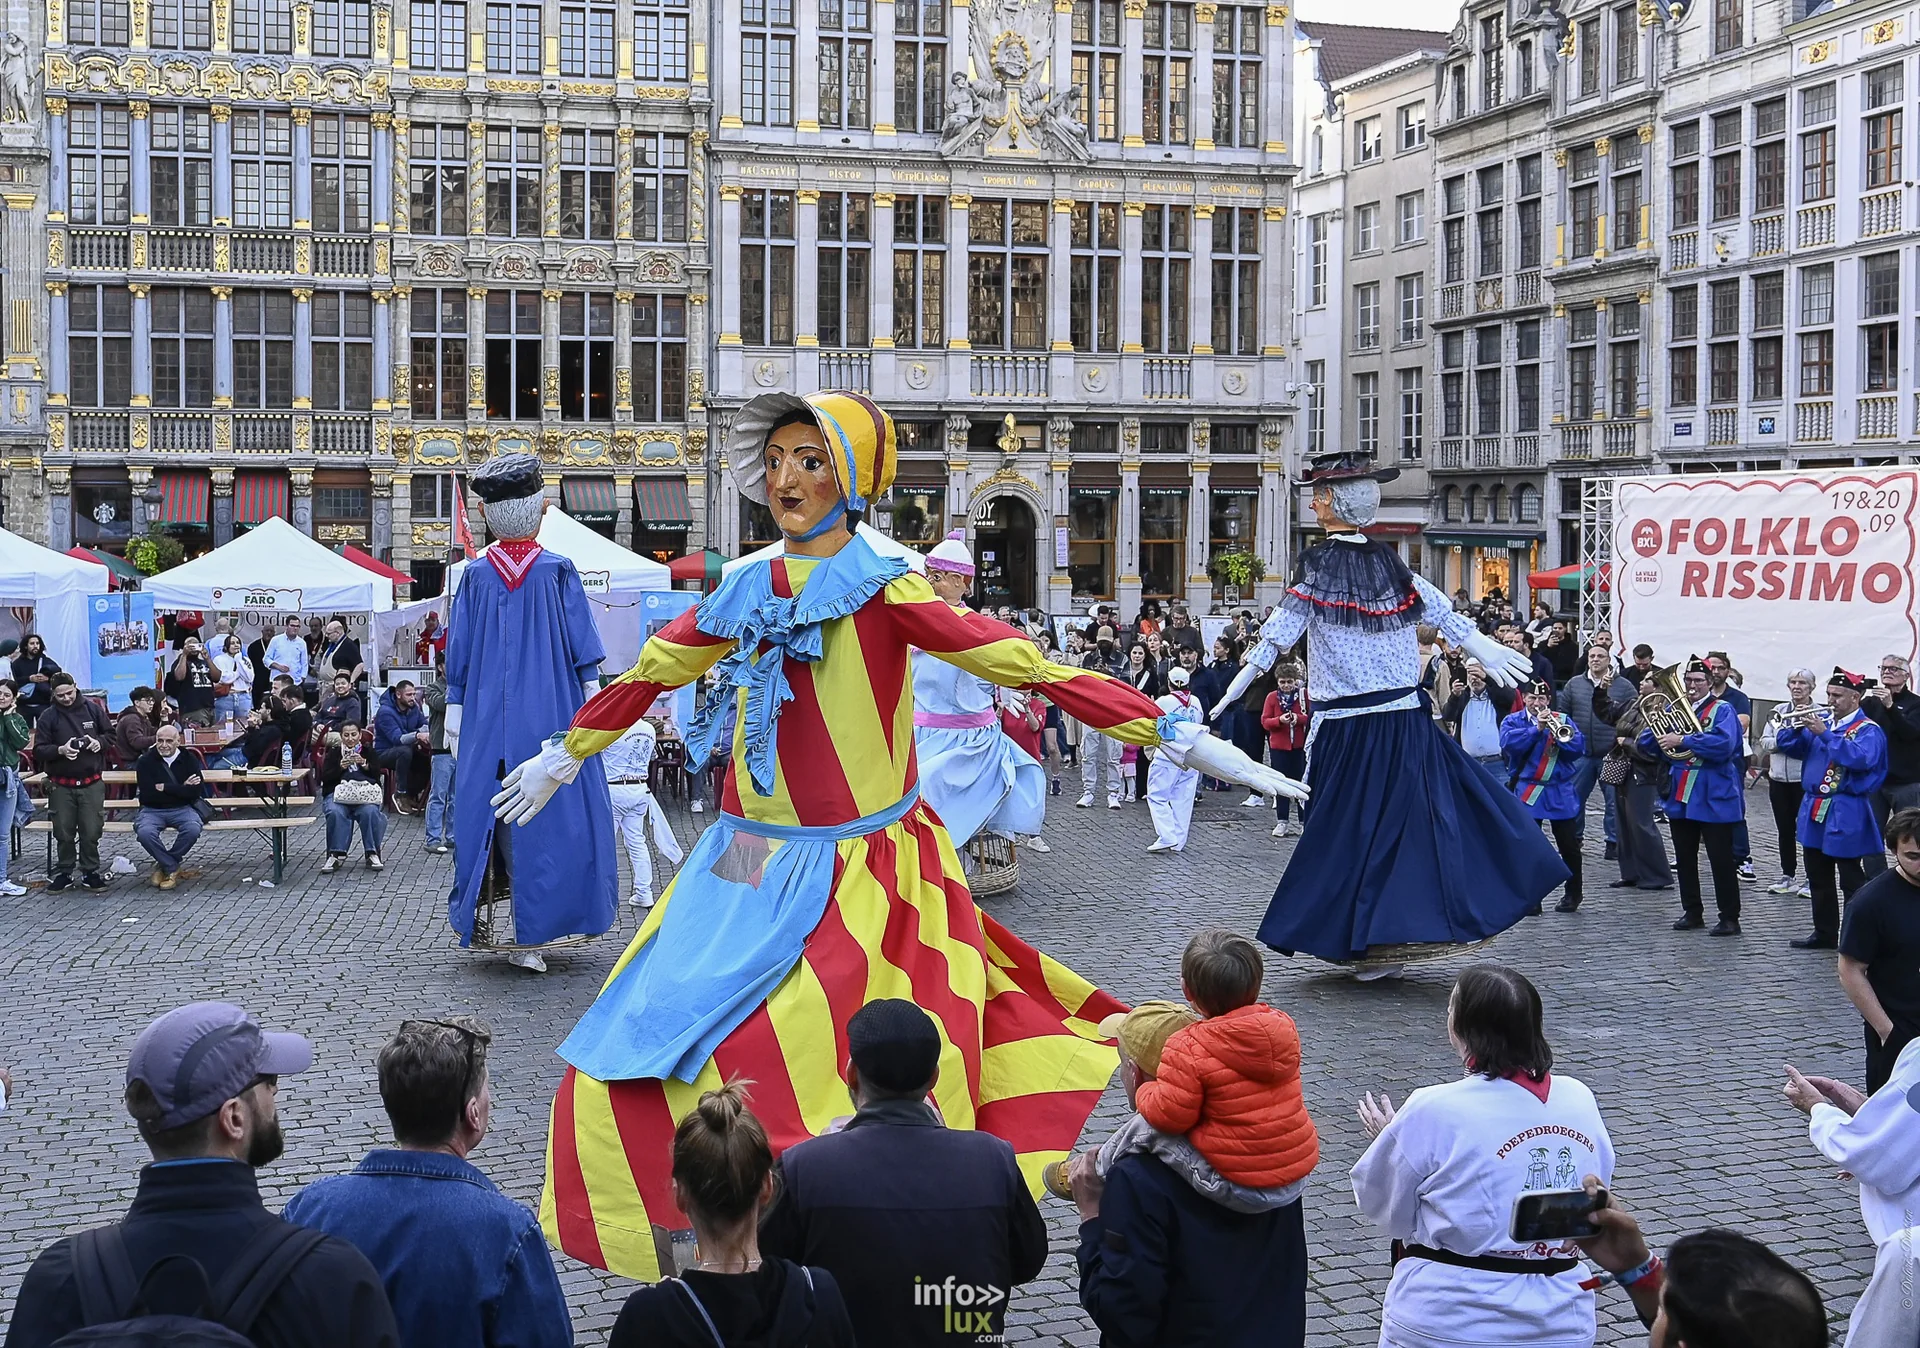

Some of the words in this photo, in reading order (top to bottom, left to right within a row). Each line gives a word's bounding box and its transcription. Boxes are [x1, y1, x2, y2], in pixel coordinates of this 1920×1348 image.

[829, 169, 861, 180] PISTOR
[1078, 178, 1115, 189] CAROLVS
[1831, 490, 1900, 510] 19&20
[1862, 514, 1896, 533] .09
[1637, 537, 1657, 548] BXL
[1667, 515, 1860, 556] FOLKLO
[1680, 561, 1902, 604] RISSIMO
[244, 595, 276, 605] FARO
[1495, 1124, 1596, 1160] POEPEDROEGERS
